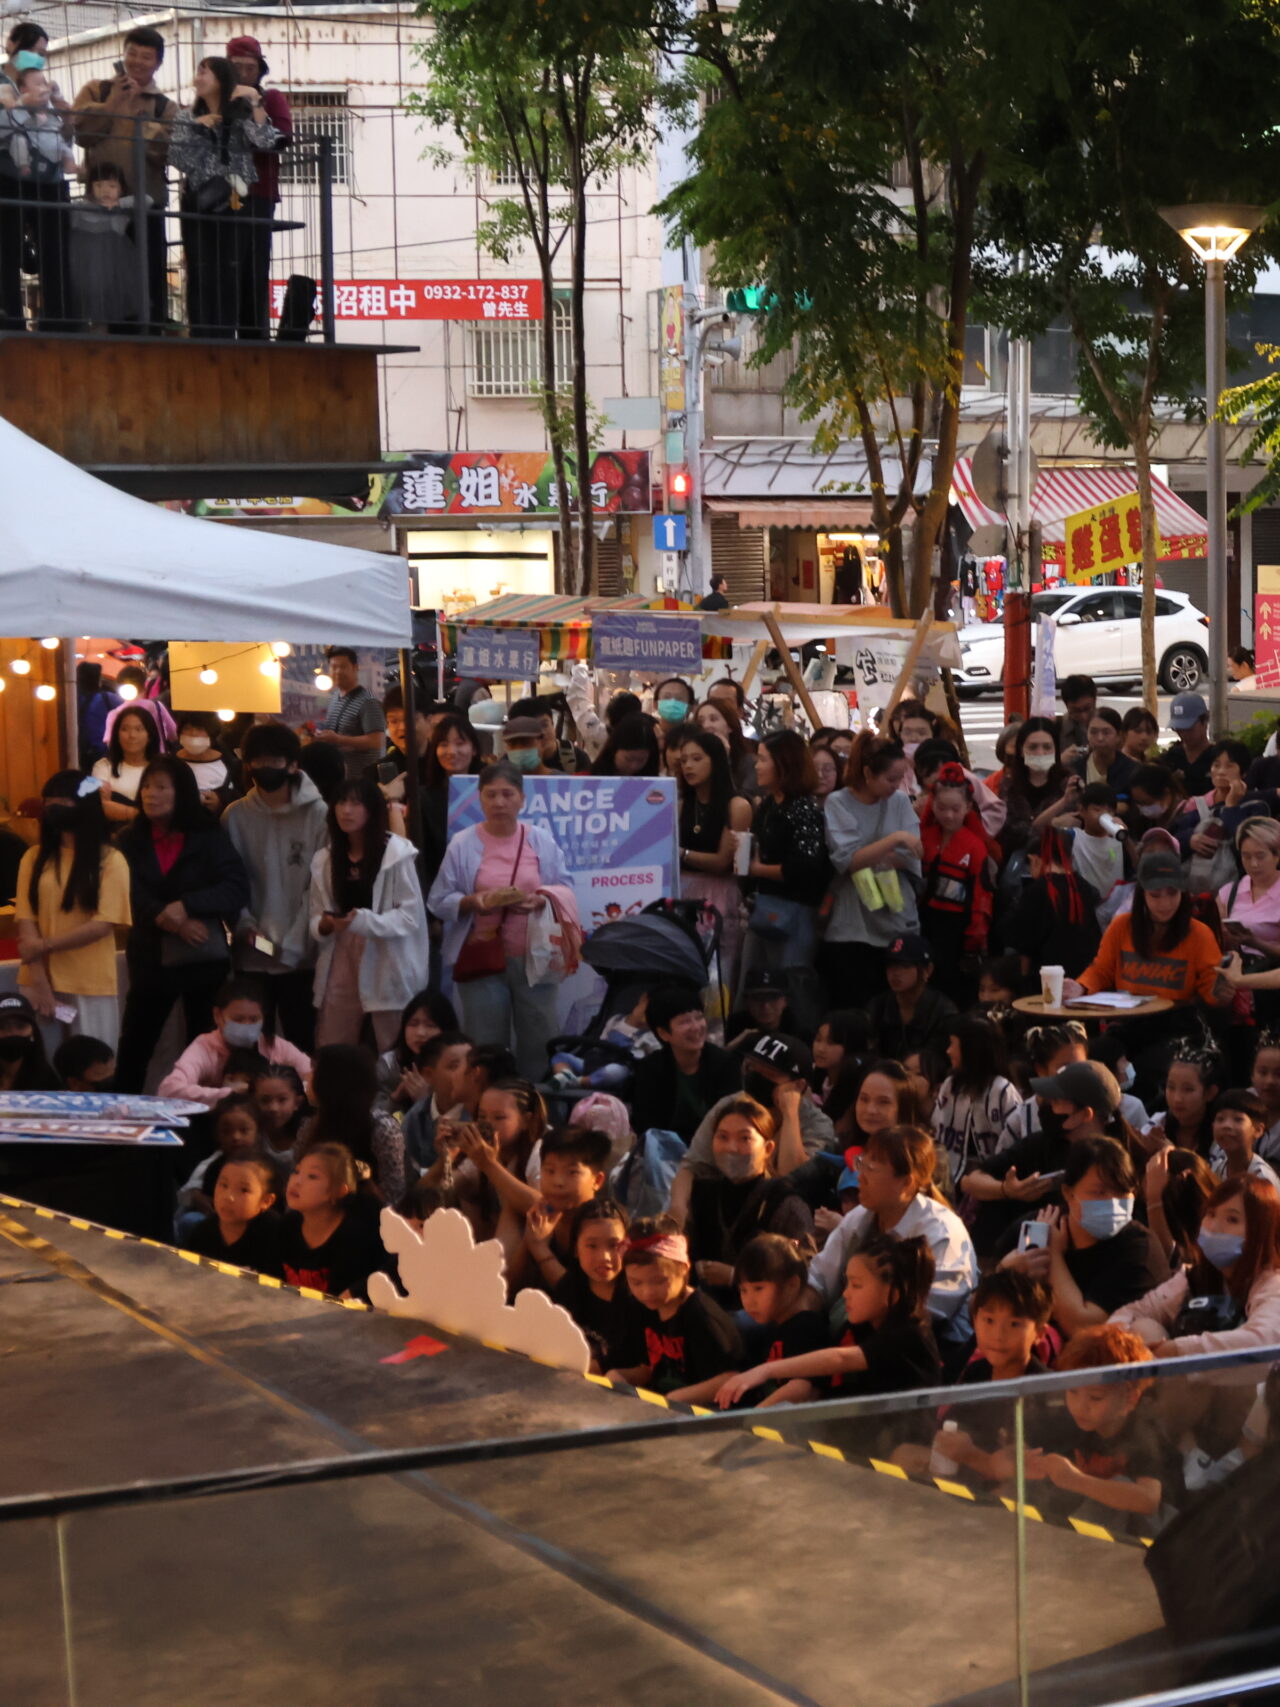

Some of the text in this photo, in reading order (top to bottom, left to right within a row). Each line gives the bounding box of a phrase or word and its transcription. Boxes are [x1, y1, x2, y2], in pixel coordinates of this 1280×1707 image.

[424, 285, 529, 300] 0932-172-837
[482, 301, 529, 317] 曾先生
[402, 464, 608, 513] 蓮姐水果行
[518, 788, 614, 814] ANCE
[591, 872, 654, 888] PROCESS
